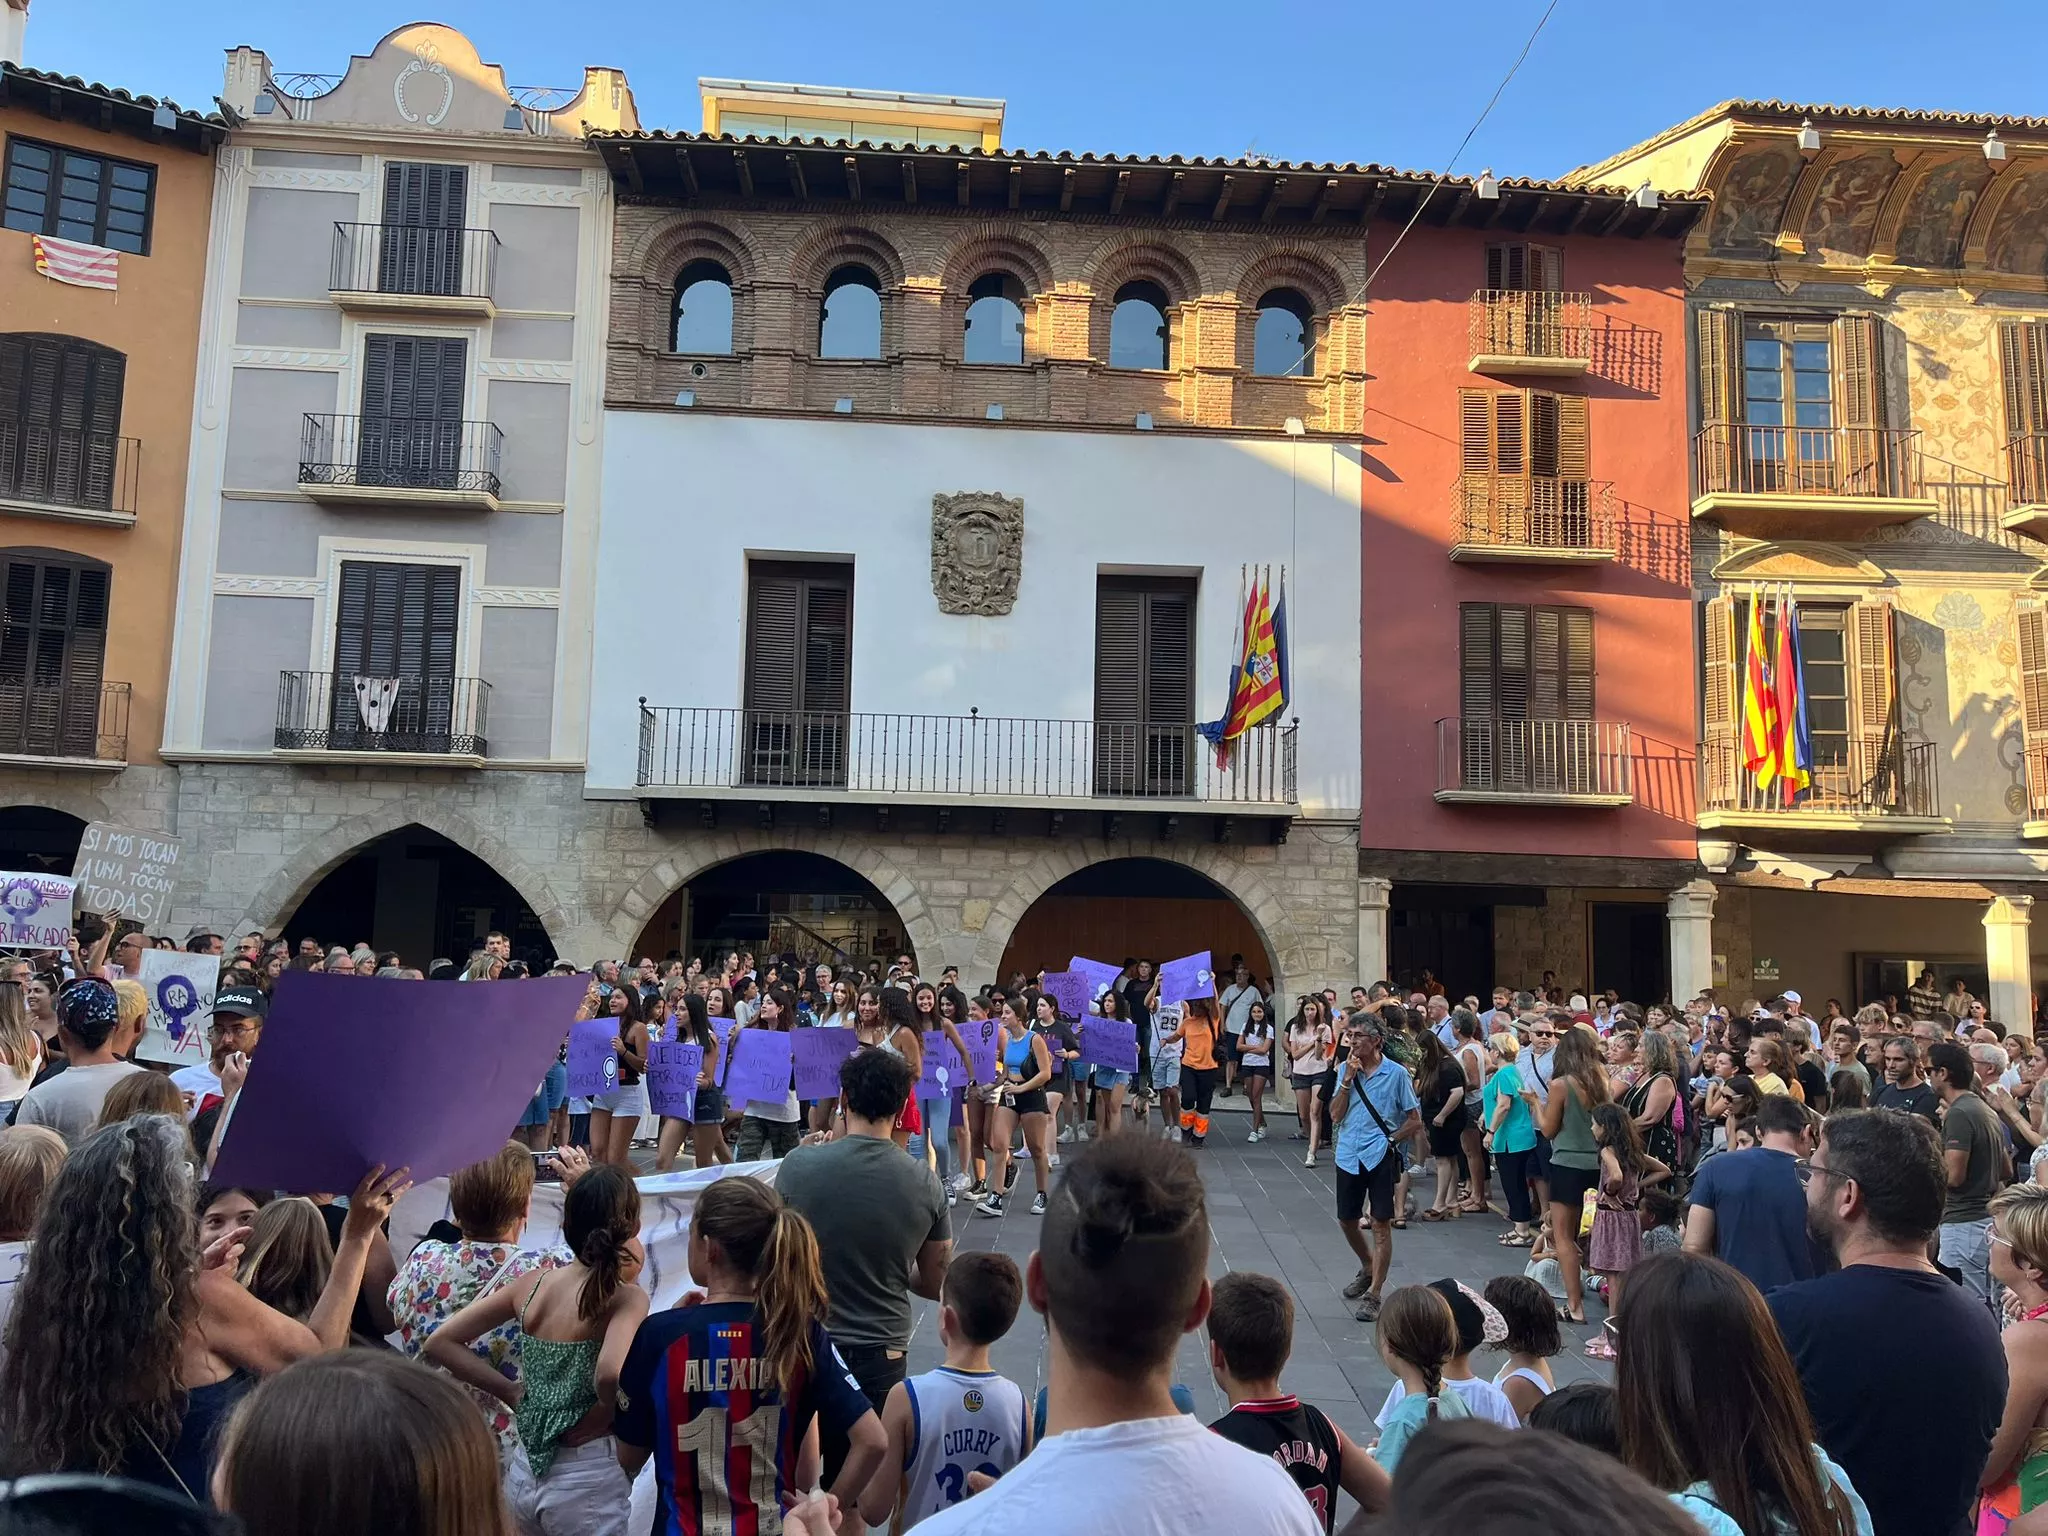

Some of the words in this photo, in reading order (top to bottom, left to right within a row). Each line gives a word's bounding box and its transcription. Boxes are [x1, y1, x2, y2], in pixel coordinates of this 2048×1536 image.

[83, 828, 101, 851] SI
[139, 838, 179, 865] TOCAN
[129, 872, 174, 893] TOCAN
[0, 921, 71, 947] RIARCADO
[216, 994, 253, 1005] adidas
[1161, 1016, 1178, 1031] 29
[943, 1428, 1001, 1456] CURRY
[677, 1405, 782, 1536] 11
[1272, 1440, 1328, 1474] ORDAN
